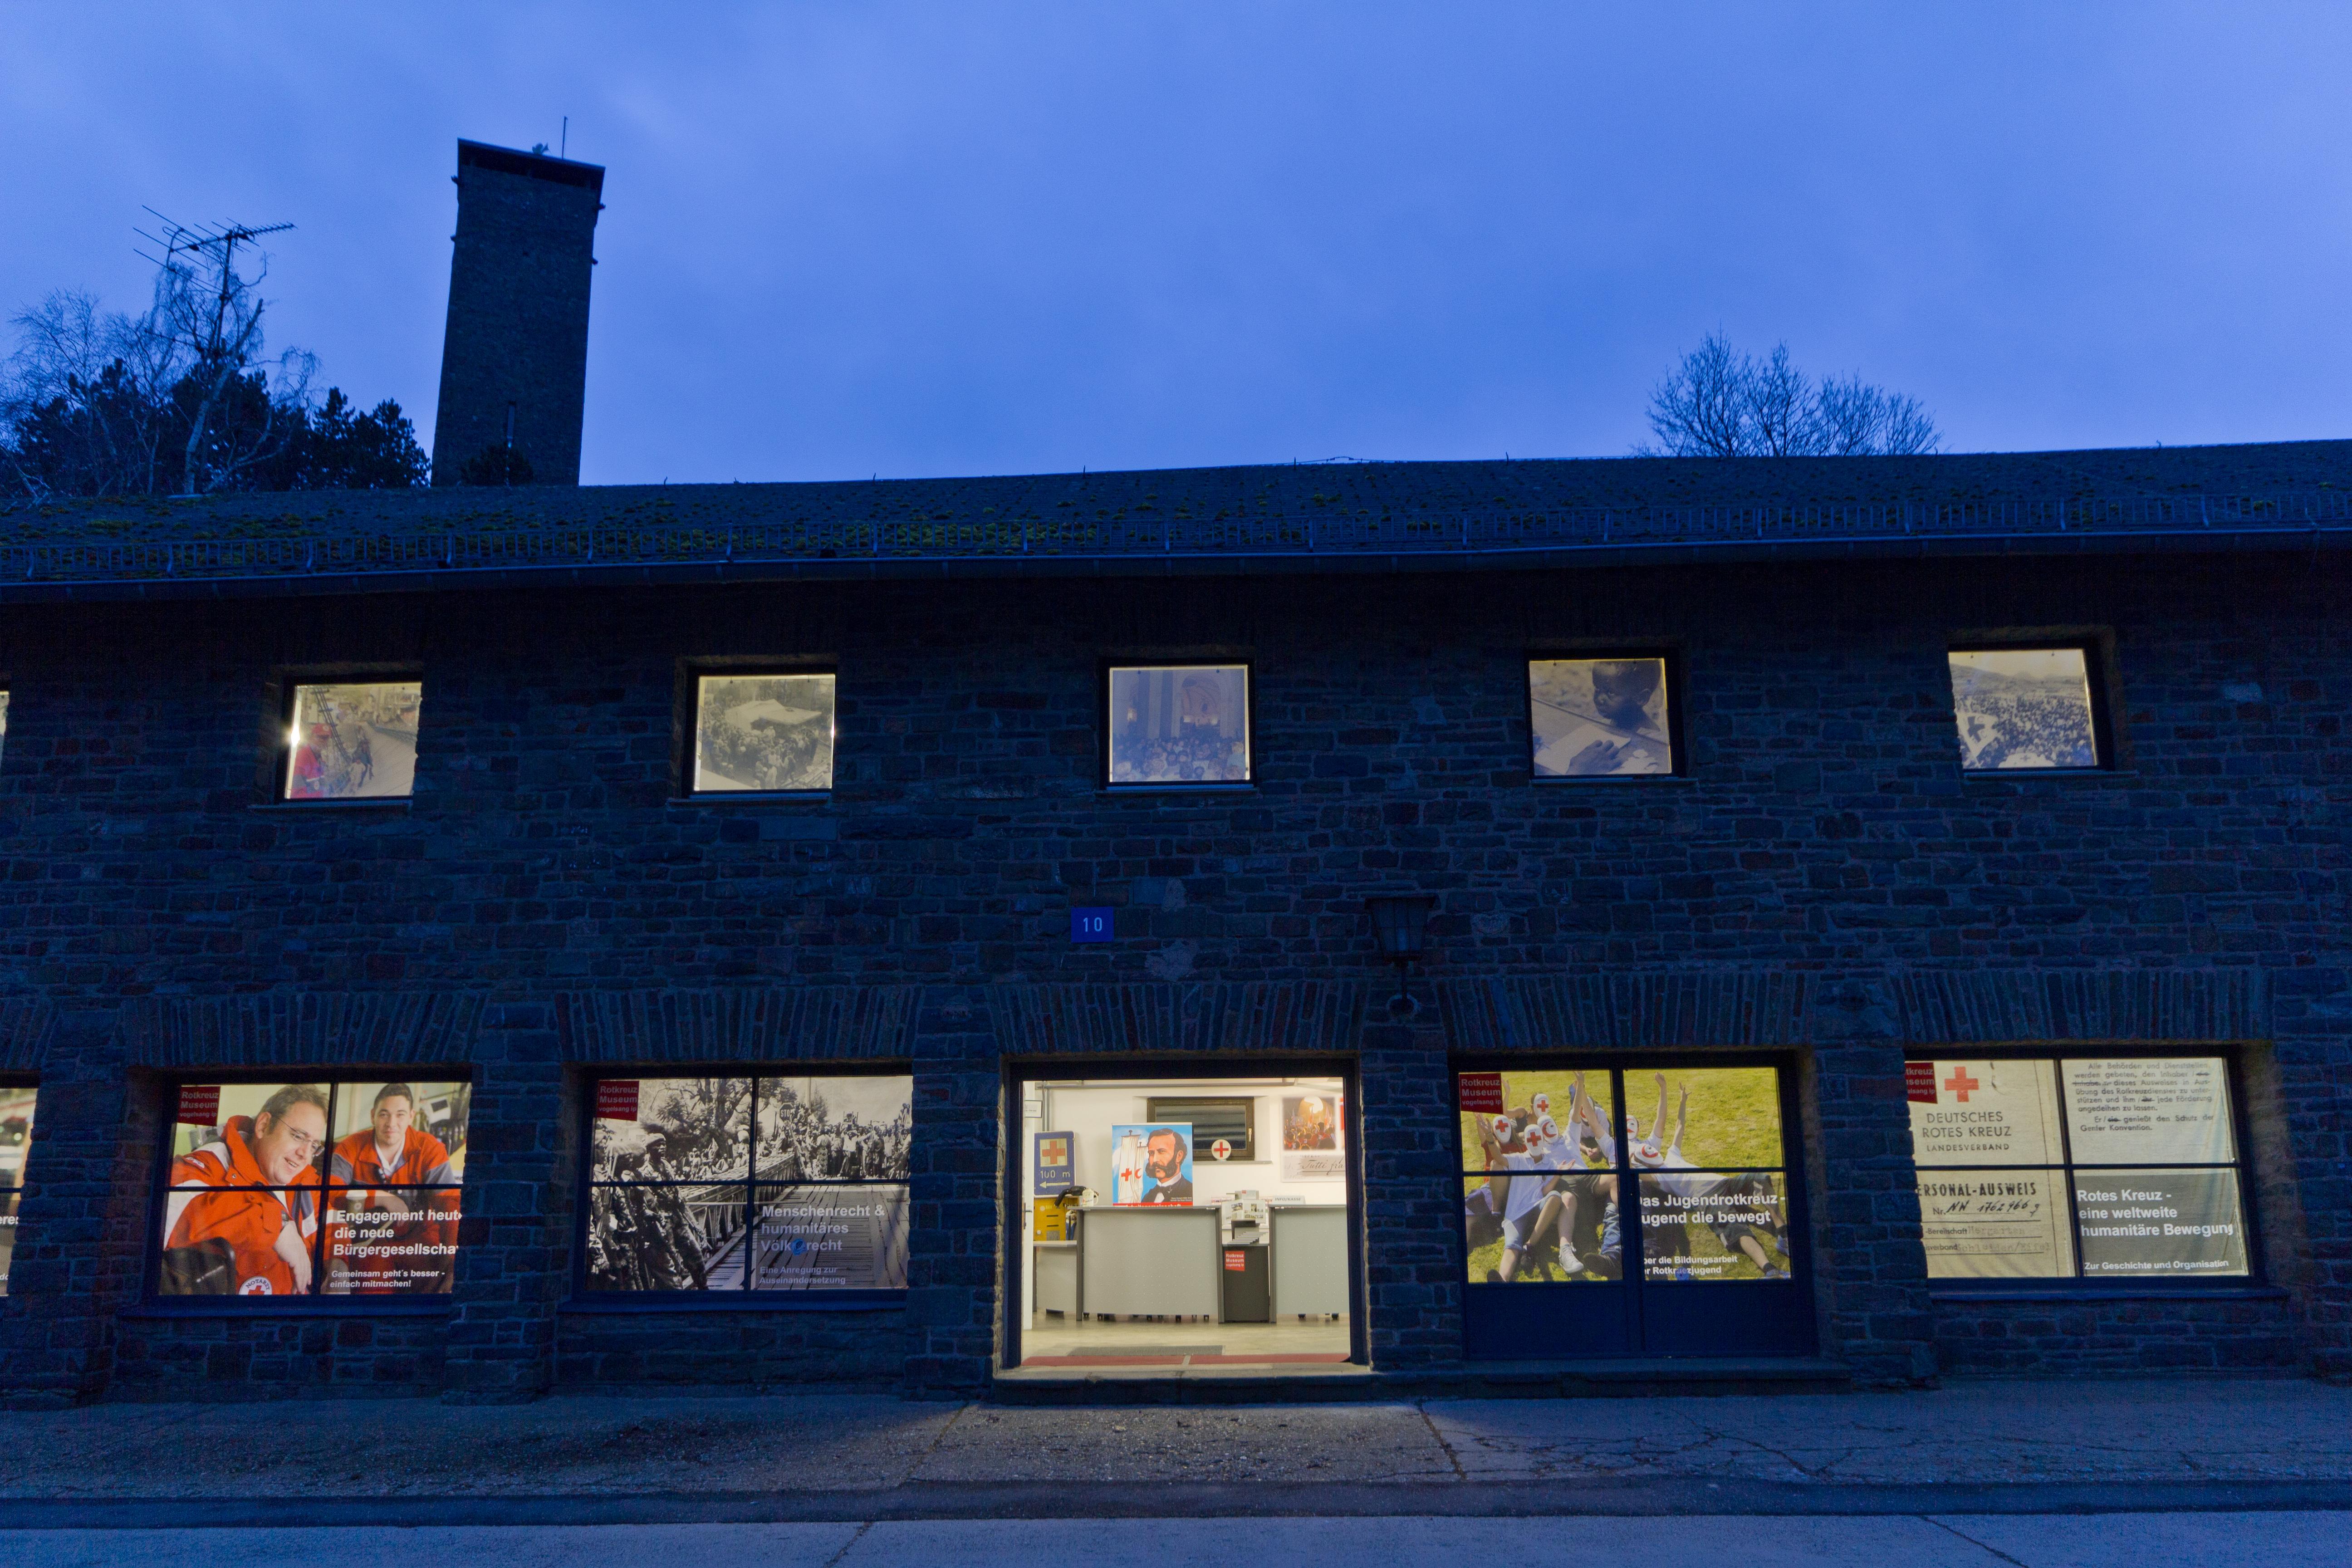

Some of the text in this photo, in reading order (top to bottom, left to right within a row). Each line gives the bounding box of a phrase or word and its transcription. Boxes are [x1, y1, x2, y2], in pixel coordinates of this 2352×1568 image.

[1083, 917, 1102, 932] 10
[1926, 1111, 2003, 1123] DEUTSCHES
[1922, 1126, 2012, 1138] ROTES KREUZ
[1040, 1170, 1056, 1179] 100
[2077, 1190, 2117, 1201] Rotes
[2122, 1189, 2162, 1201] Kreuz
[1664, 1194, 1778, 1209] Jugendrotkreuz
[336, 1210, 424, 1224] Engagement
[762, 1205, 885, 1217] Menschenrecht &
[2079, 1206, 2178, 1219] eine weltweite
[1691, 1211, 1714, 1224] die
[1718, 1210, 1771, 1225] bewegt
[334, 1227, 394, 1239] die neue
[762, 1222, 849, 1234] humanitäres
[2081, 1223, 2233, 1237] humanitäre Bewegung
[333, 1243, 459, 1258] Bürgergesellscha
[761, 1239, 843, 1251] Völkrecht
[1674, 1255, 1738, 1265] Bildungsarbeit
[2102, 1261, 2152, 1269] Geschichte
[2154, 1261, 2171, 1269] und
[2173, 1260, 2229, 1270] Organisation
[780, 1266, 822, 1275] Anregung
[245, 1279, 270, 1290] NOTARZT
